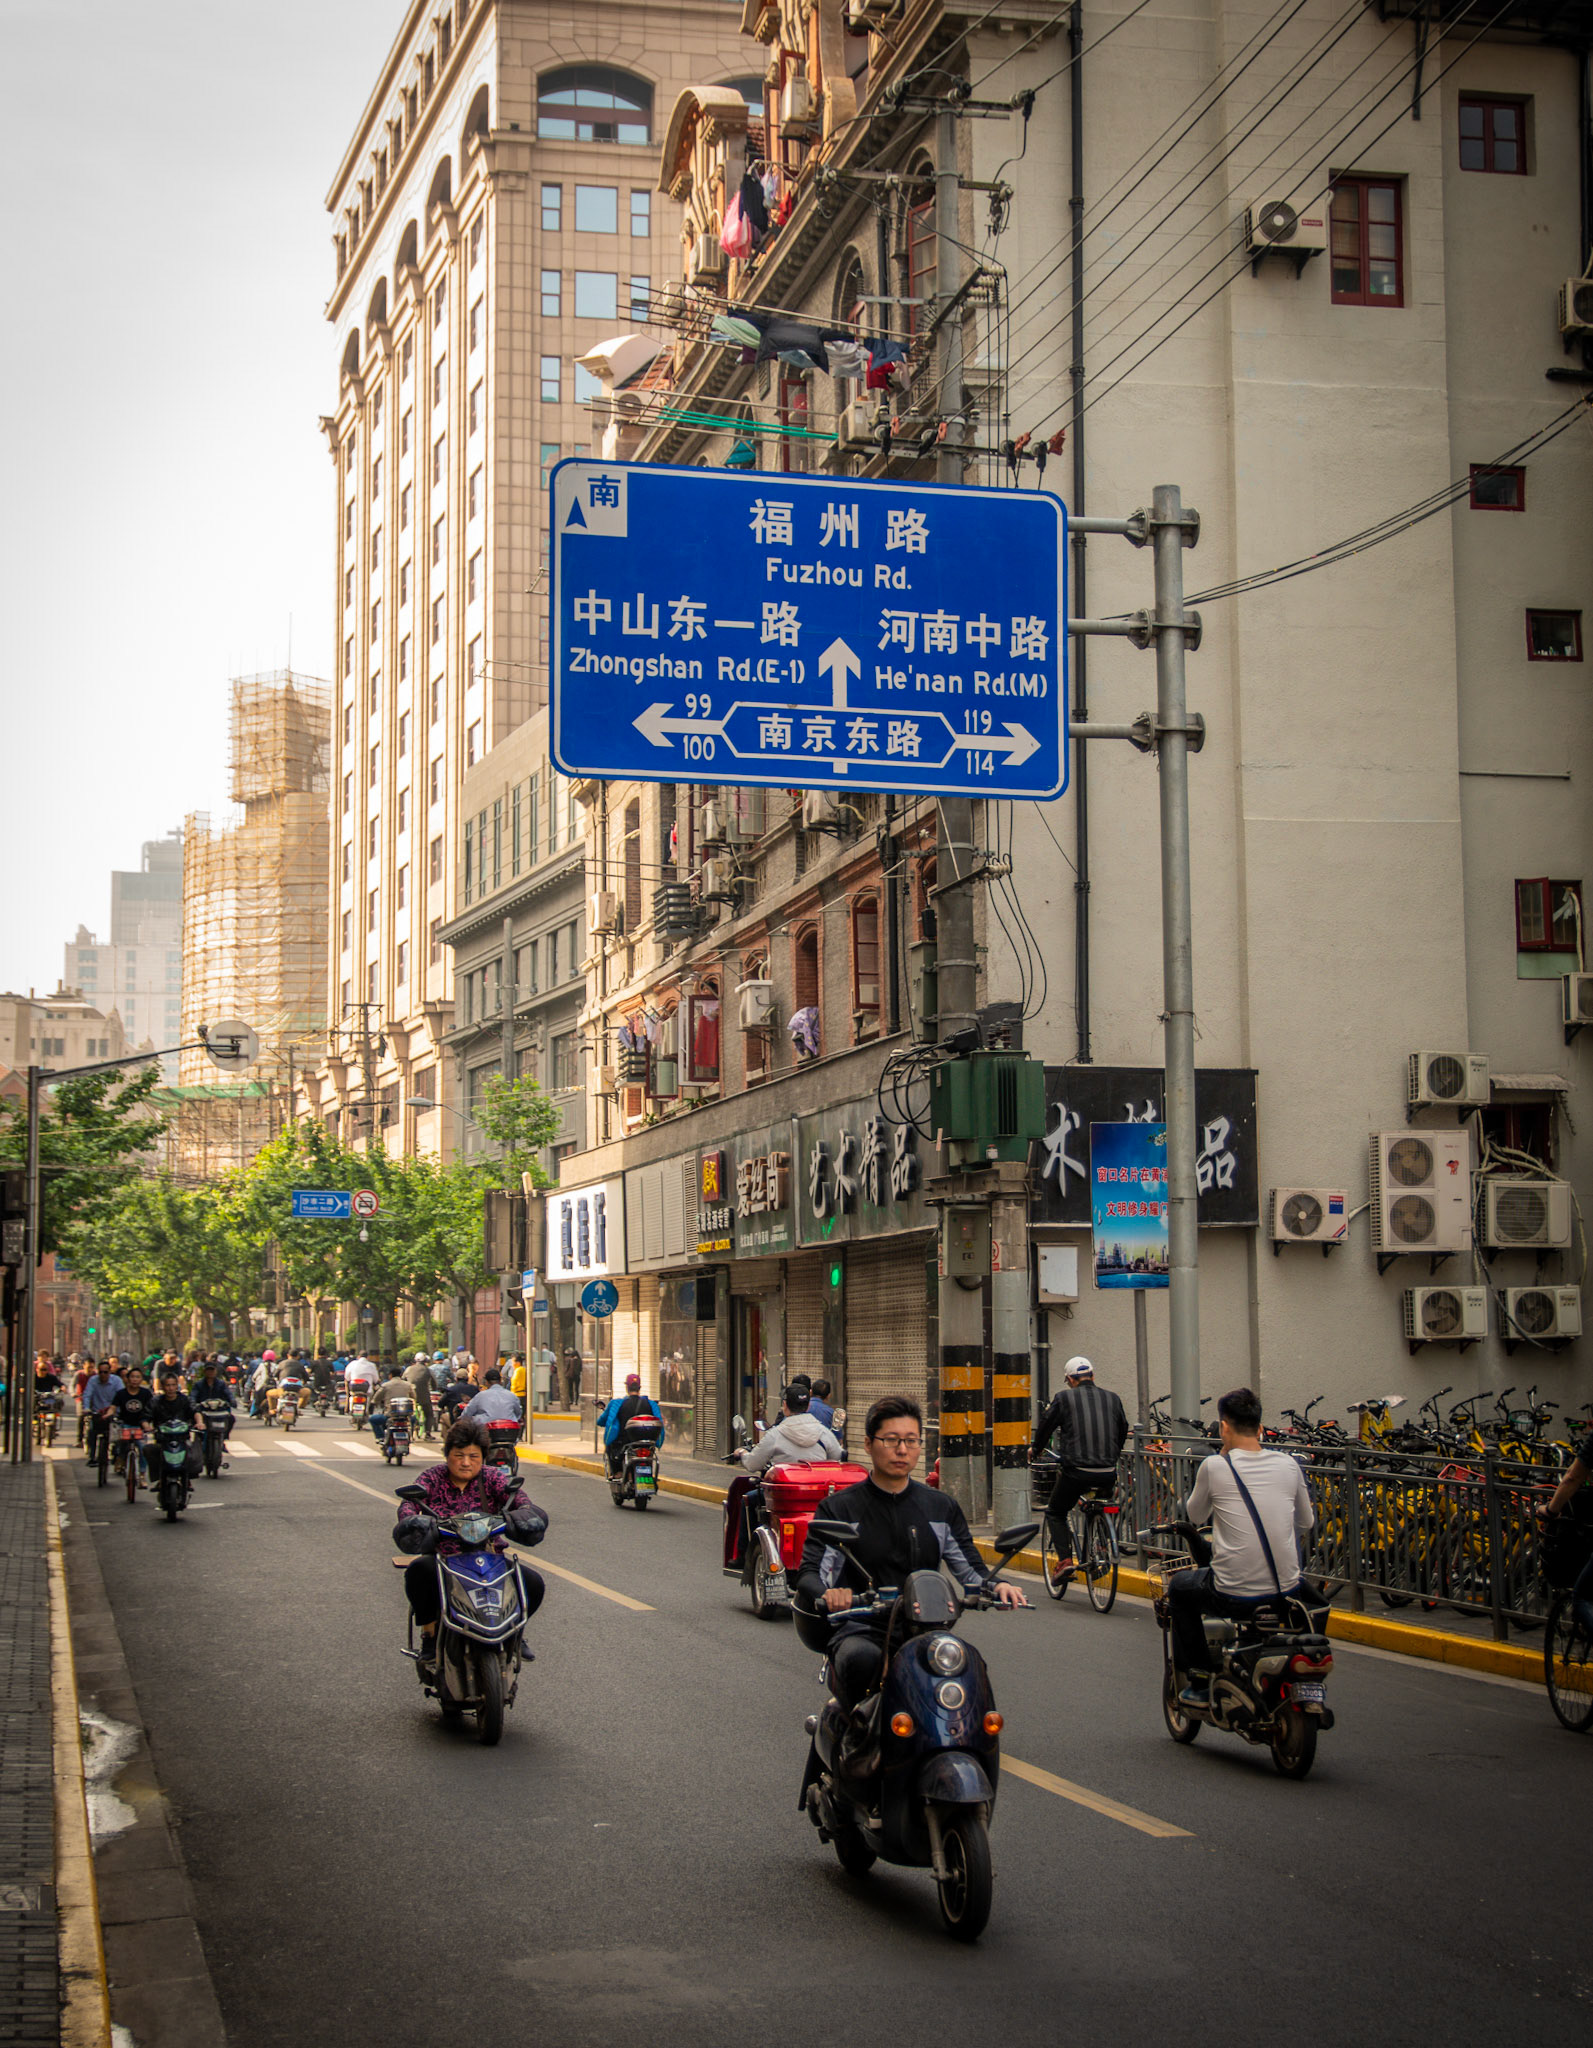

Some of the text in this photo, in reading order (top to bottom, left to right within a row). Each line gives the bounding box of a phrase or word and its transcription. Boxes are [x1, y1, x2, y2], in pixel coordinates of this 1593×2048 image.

[587, 474, 621, 508] 南
[748, 498, 930, 554] 福州路
[766, 557, 912, 590] Fuzhou Rd.
[572, 588, 803, 647] 中山东一路
[877, 608, 1050, 661] 河南中路
[568, 647, 806, 684] Zhongshan Rd.(E-1)
[874, 665, 1048, 698] He'nan Rd.(M)
[684, 693, 712, 718] 99
[963, 709, 992, 734] 119
[683, 735, 716, 761] 100
[756, 712, 923, 758] 南京东路
[965, 750, 995, 776] 114
